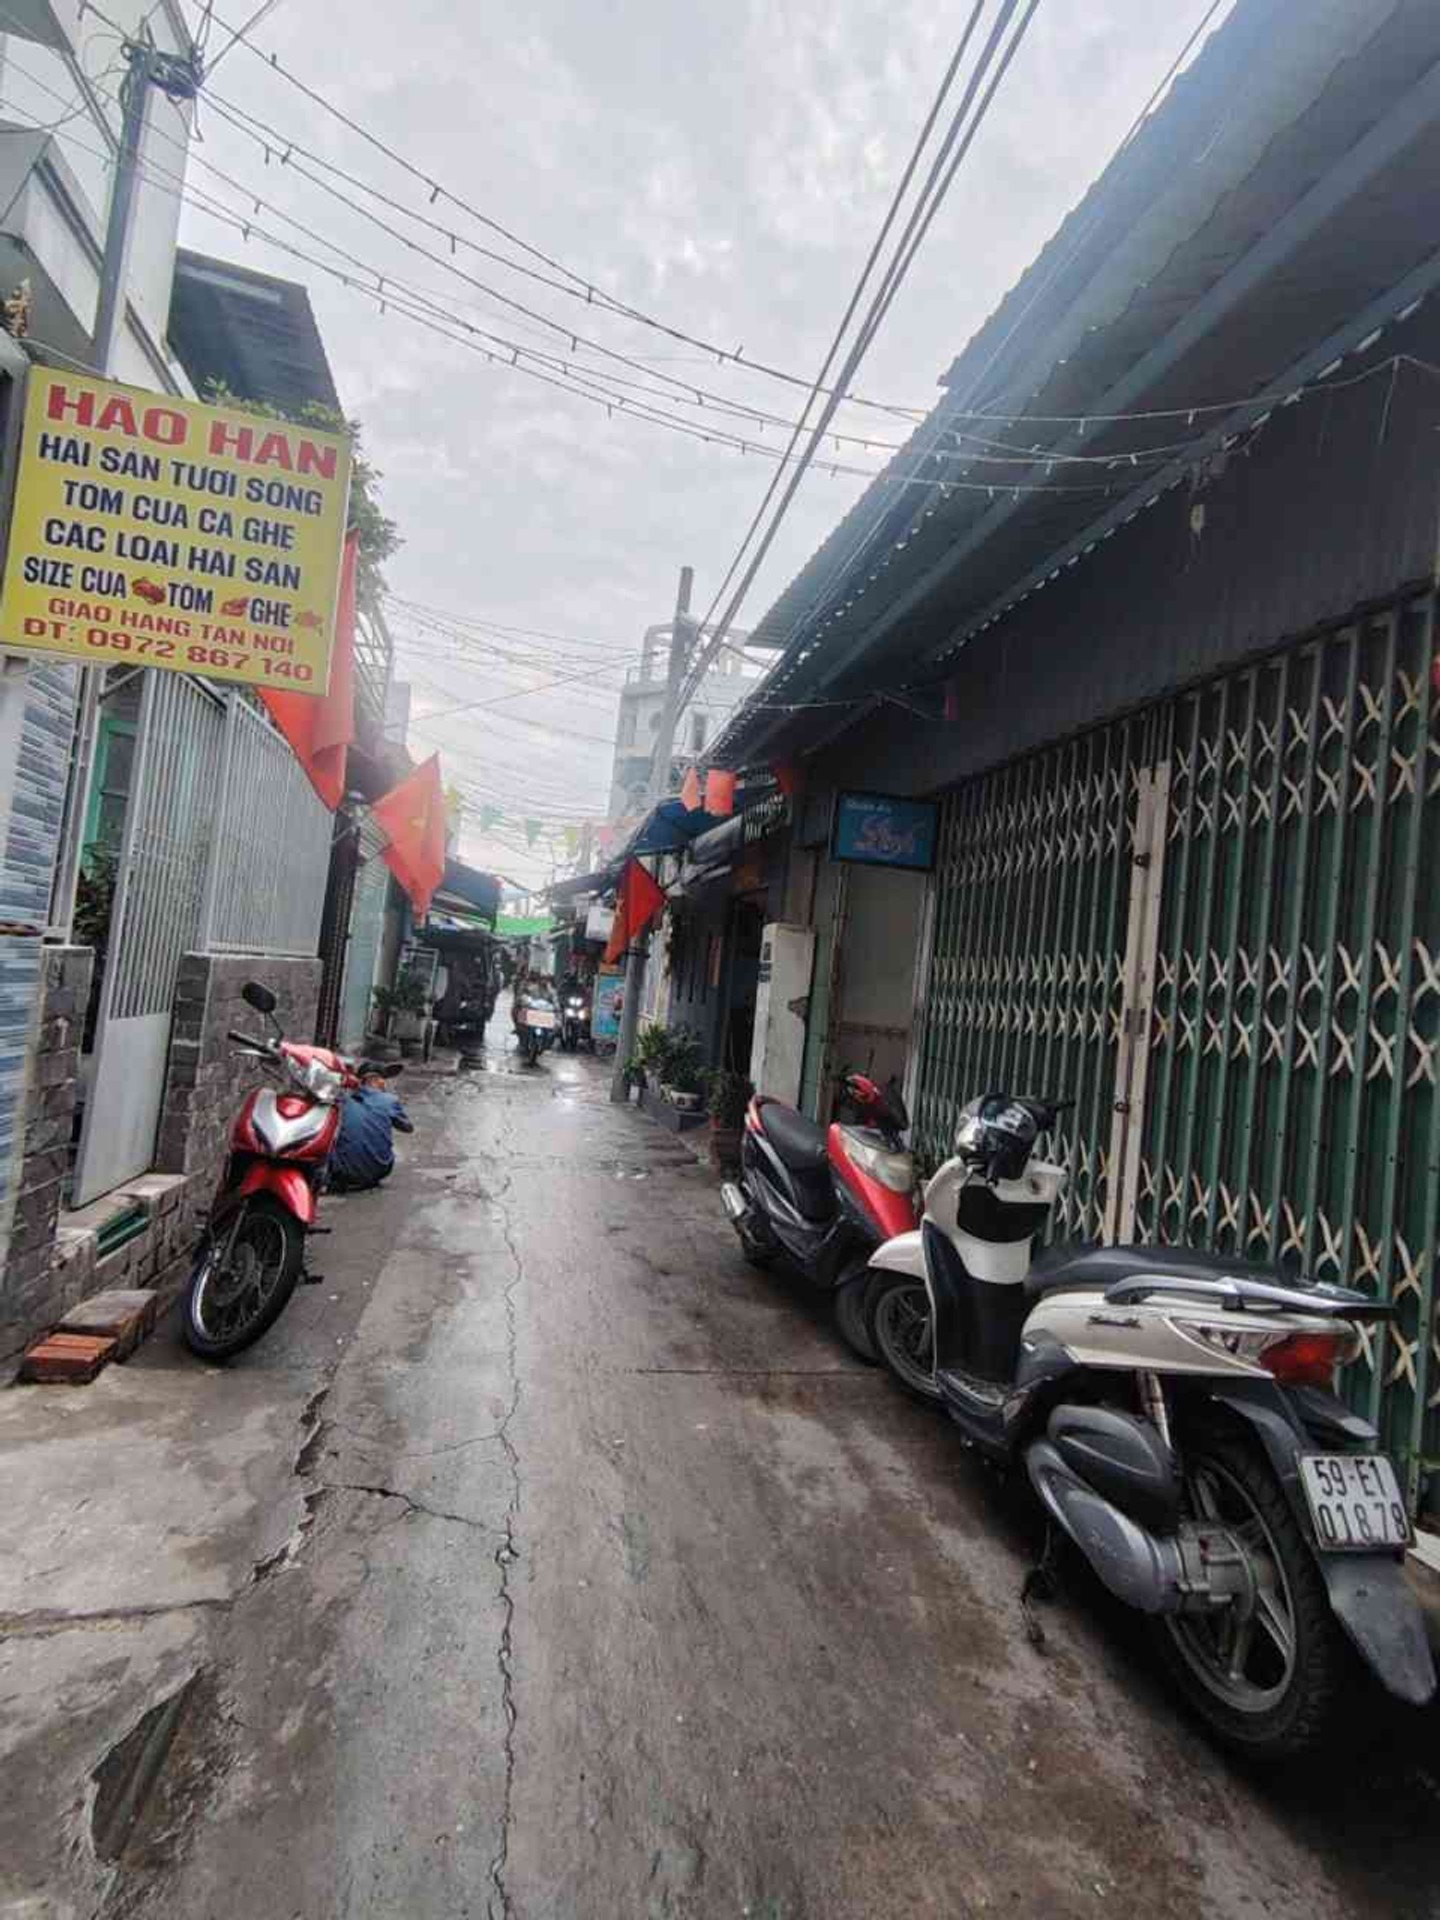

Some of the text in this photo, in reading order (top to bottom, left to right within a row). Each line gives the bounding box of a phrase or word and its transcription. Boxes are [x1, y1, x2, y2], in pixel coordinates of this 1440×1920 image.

[132, 496, 188, 530] CUA
[23, 556, 74, 588] SIZE
[80, 567, 127, 599] CUA
[48, 597, 112, 624] GIAO
[86, 627, 176, 661] 0972
[186, 645, 249, 670] 867
[258, 657, 313, 682] 140
